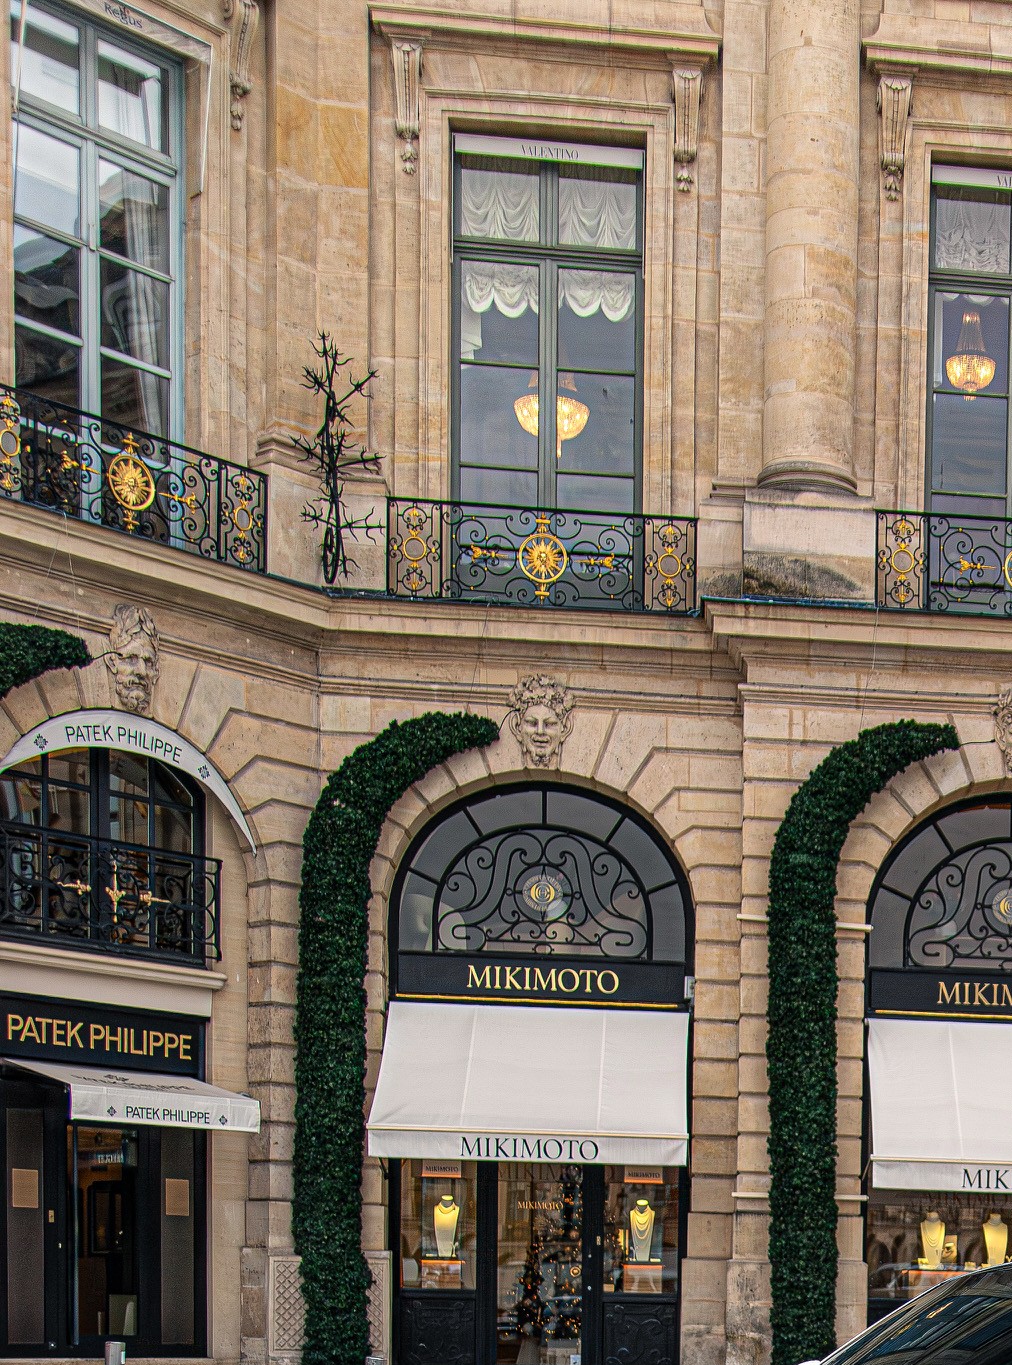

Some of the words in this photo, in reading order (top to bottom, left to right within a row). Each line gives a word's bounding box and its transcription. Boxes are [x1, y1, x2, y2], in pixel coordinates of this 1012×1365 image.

[104, 2, 143, 28] Regus
[521, 144, 579, 160] VALENTINO
[65, 725, 114, 742] PATEK
[117, 726, 182, 763] PHILIPPE
[466, 964, 620, 994] MIKIMOTO
[7, 1013, 84, 1049] PATEK
[89, 1023, 192, 1060] PHILIPPE
[125, 1105, 160, 1120] PATEK
[162, 1108, 211, 1124] PHILIPPE
[460, 1136, 599, 1161] MIKIMOTO
[425, 1165, 459, 1173] MIKIMOTO
[517, 1200, 564, 1211] MIKIMOTO
